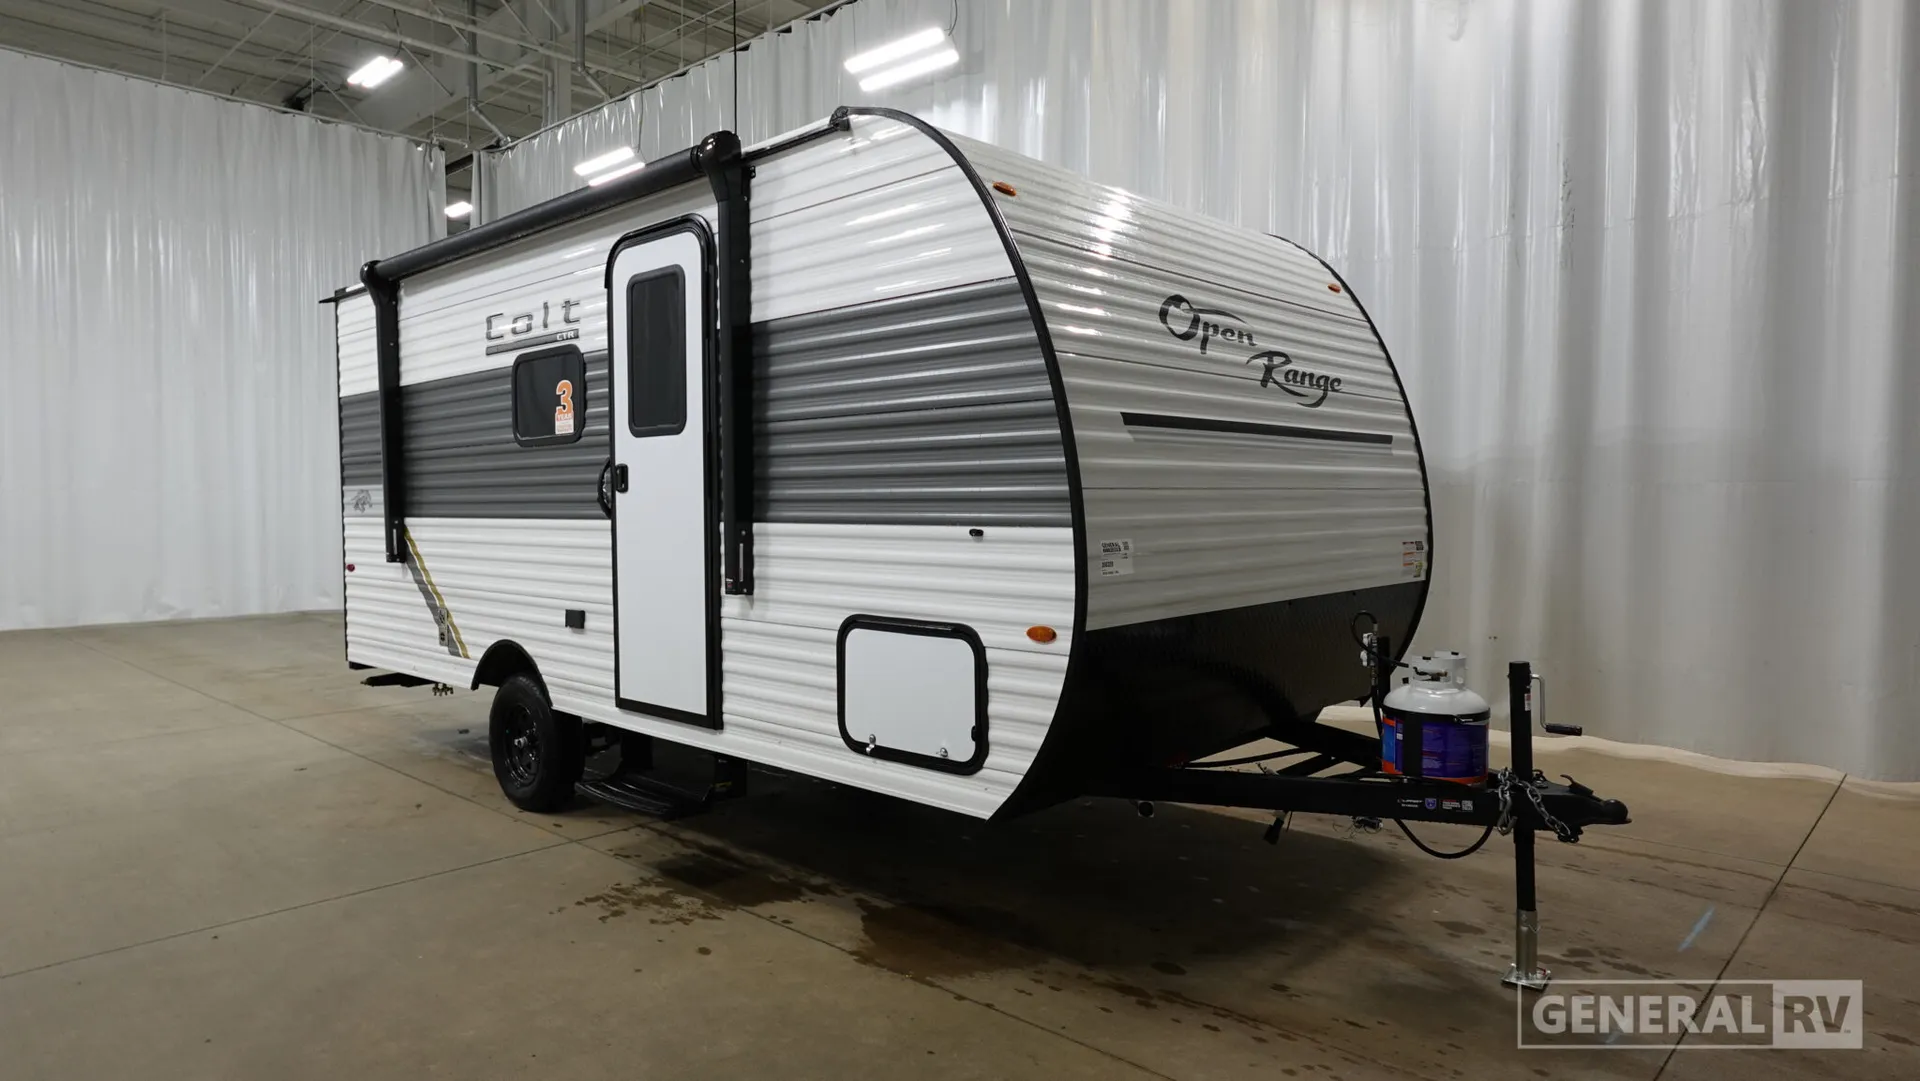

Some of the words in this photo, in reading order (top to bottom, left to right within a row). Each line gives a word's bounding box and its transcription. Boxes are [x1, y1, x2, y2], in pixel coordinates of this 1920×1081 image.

[485, 299, 580, 341] Colt
[556, 331, 575, 341] CTR
[1158, 294, 1258, 354] Open
[556, 380, 573, 414] 3
[1245, 350, 1343, 409] Range
